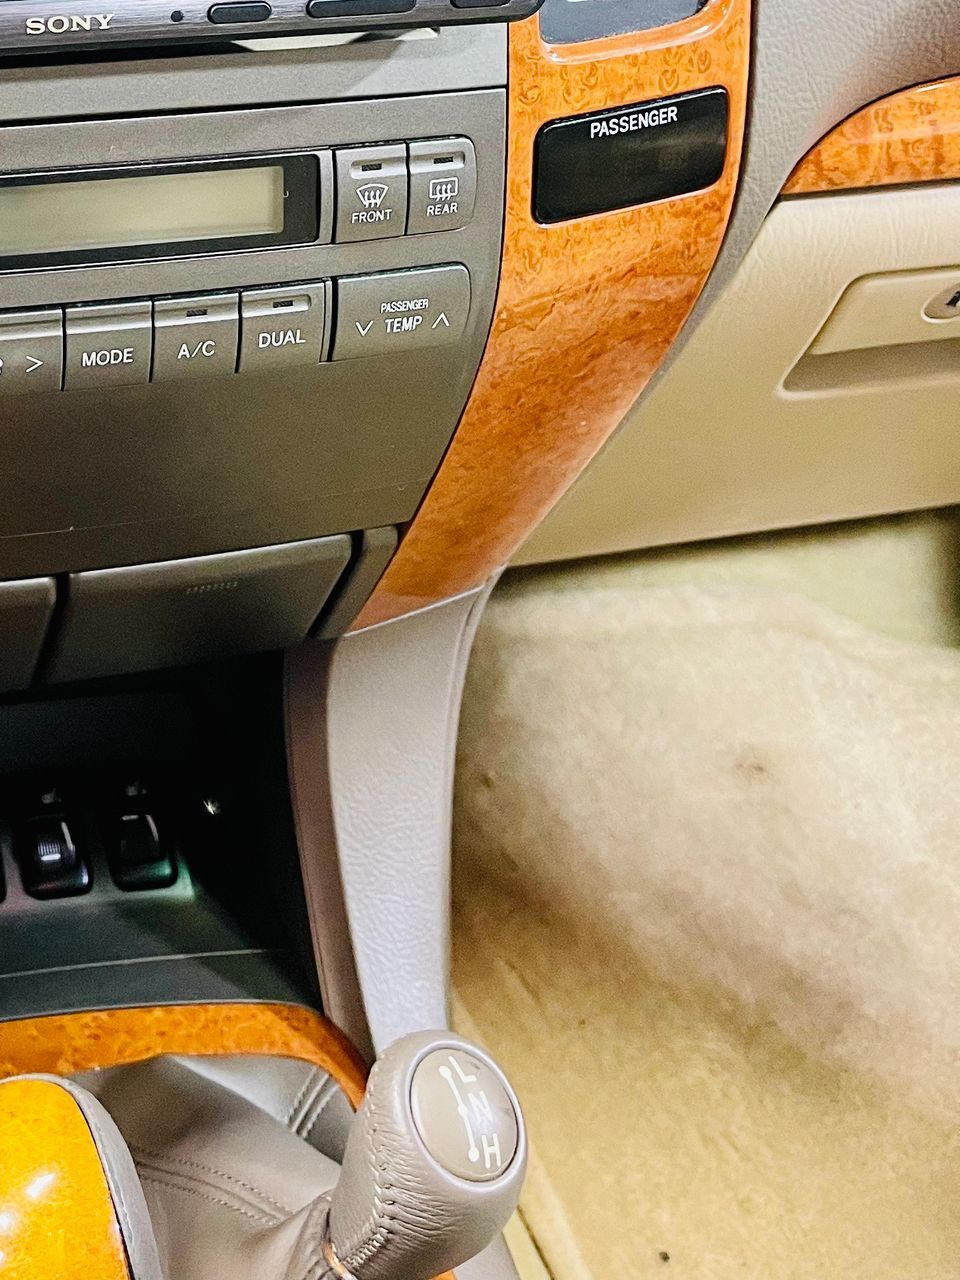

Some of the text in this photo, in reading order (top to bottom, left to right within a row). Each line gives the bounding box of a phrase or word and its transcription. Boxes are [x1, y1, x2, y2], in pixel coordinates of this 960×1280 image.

[25, 13, 115, 35] SONY
[590, 106, 678, 139] PASSENGER
[351, 209, 392, 224] FRONT
[426, 202, 459, 216] REAR
[380, 298, 429, 314] PASSENGER
[385, 315, 423, 334] TEMP
[258, 330, 307, 349] DUAL
[81, 347, 134, 367] MODE
[177, 340, 216, 360] A/C
